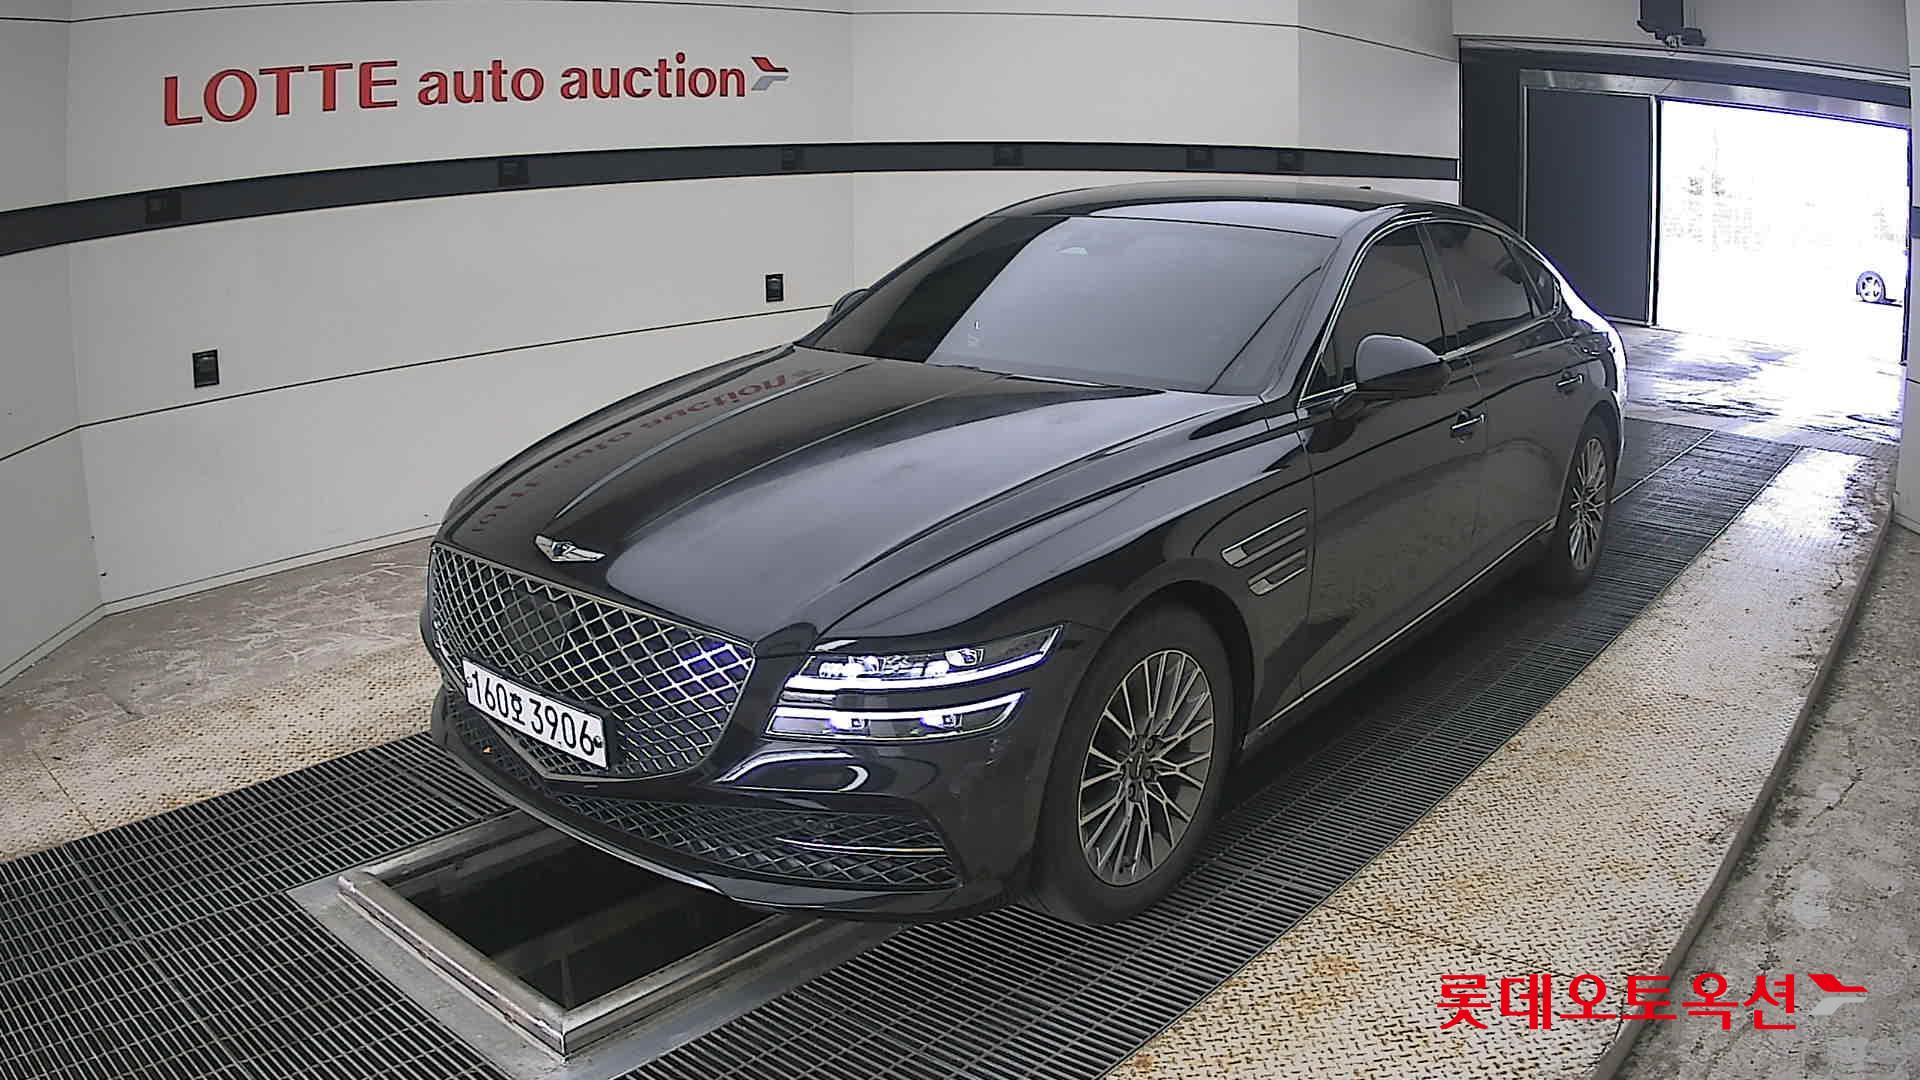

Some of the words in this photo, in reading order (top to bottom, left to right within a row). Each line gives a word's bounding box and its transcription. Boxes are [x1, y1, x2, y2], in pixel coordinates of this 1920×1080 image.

[163, 60, 398, 126] LOTTE
[416, 59, 545, 105] auto
[560, 51, 747, 99] auction
